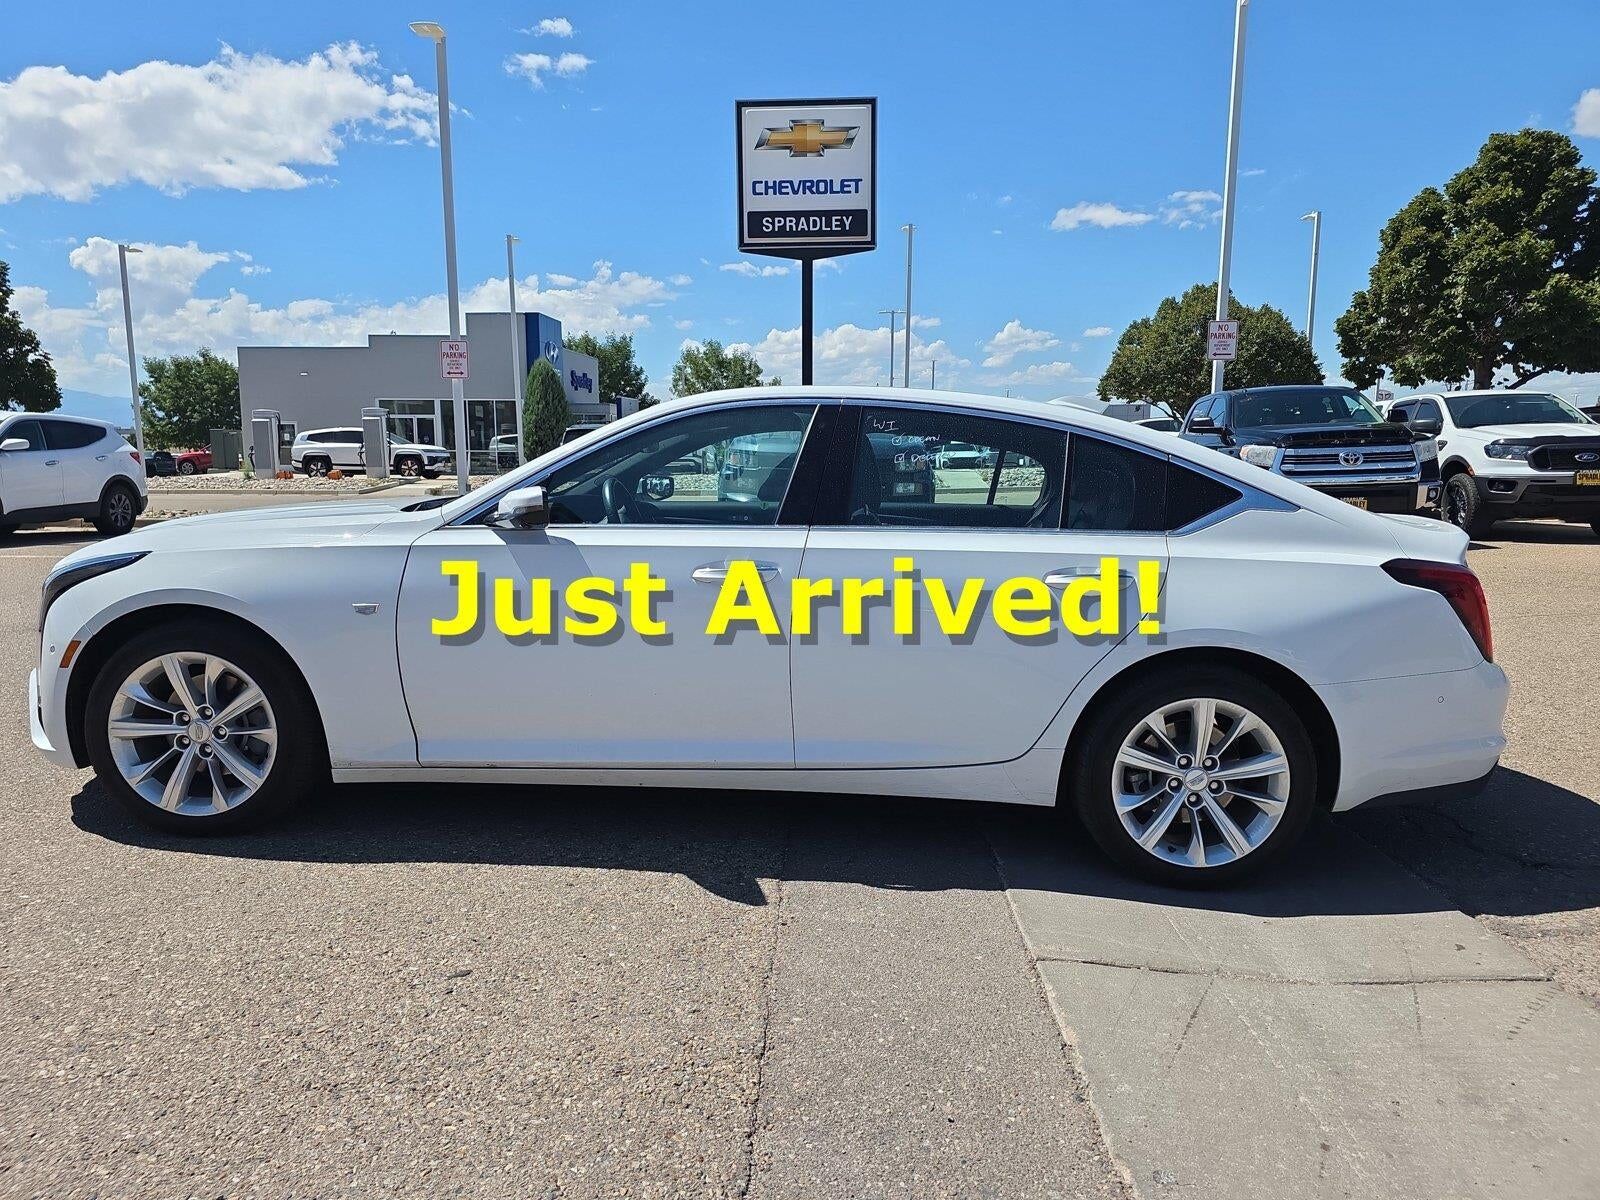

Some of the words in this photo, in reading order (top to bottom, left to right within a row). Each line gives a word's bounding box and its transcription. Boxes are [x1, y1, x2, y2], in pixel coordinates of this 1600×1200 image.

[752, 178, 863, 195] CHEVROLET
[762, 215, 853, 232] SPRADLEY
[1210, 332, 1236, 340] PARKING
[442, 351, 467, 359] PARKING
